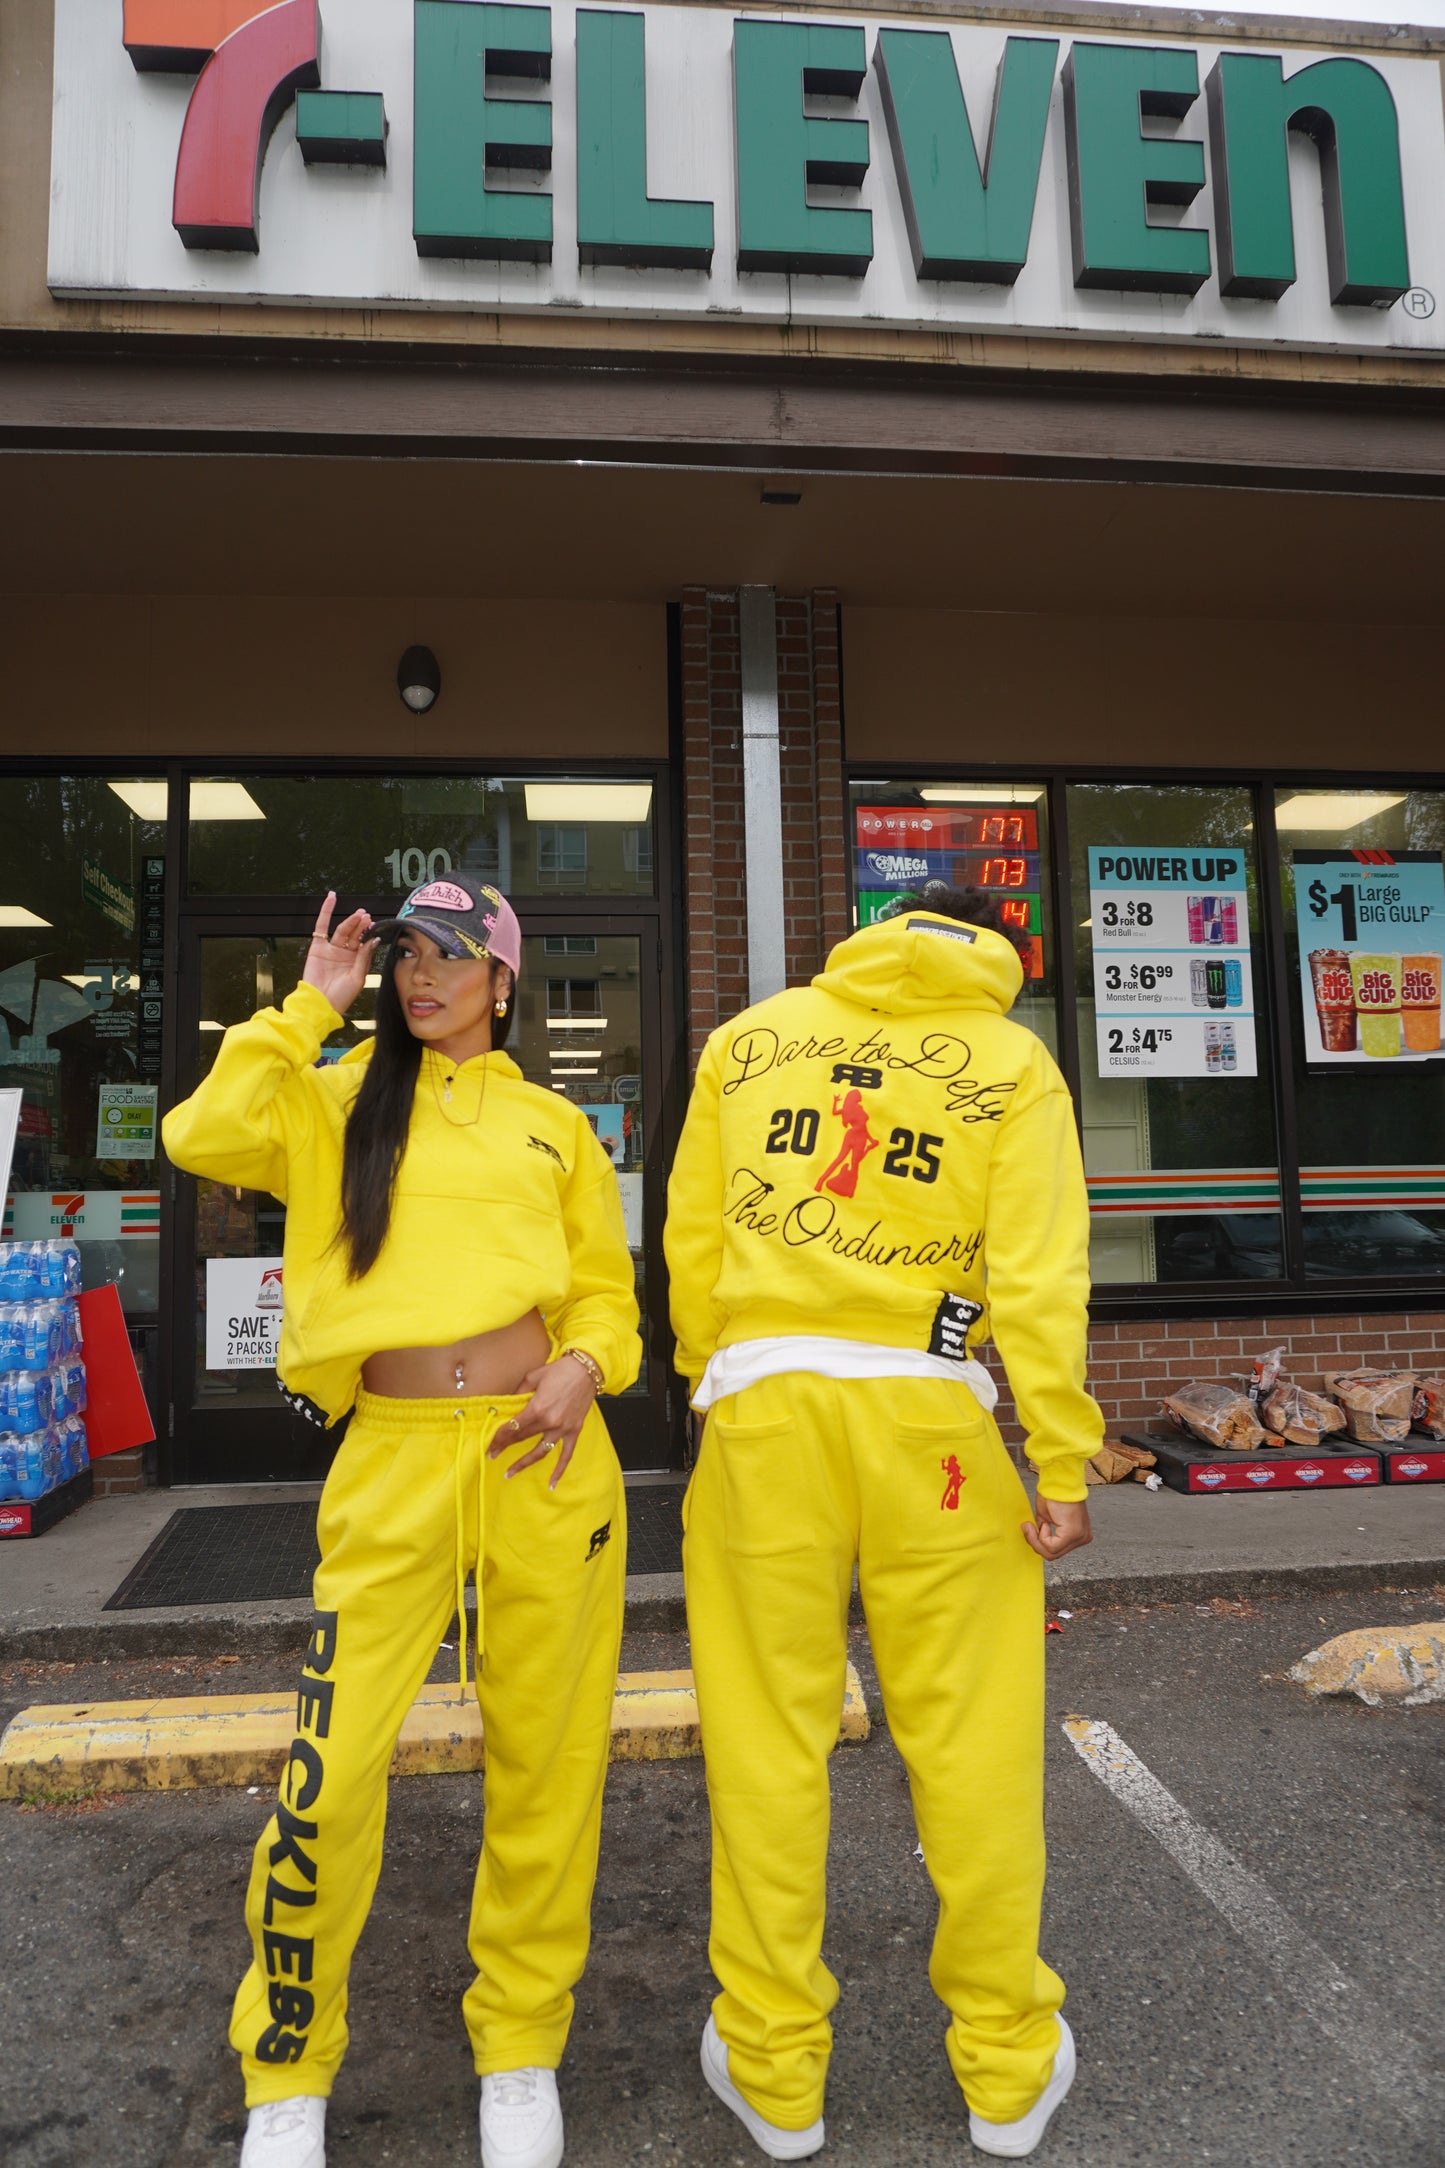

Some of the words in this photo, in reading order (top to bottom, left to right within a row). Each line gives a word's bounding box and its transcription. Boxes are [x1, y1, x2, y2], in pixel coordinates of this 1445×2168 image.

[982, 817, 1022, 841] 177
[384, 848, 451, 888] 100
[886, 856, 928, 871] MEGA
[984, 859, 1024, 885] 173
[1098, 857, 1188, 881] POWER
[1192, 858, 1238, 881] UP
[885, 871, 928, 880] MILLIONS
[84, 860, 100, 887] Self
[101, 874, 134, 913] Checkout
[430, 886, 463, 903] Dutch
[1358, 884, 1400, 905] Large
[1102, 902, 1119, 926] 3
[1120, 918, 1135, 926] FOR
[1308, 880, 1358, 941] $1
[1360, 906, 1386, 922] BIG
[1389, 905, 1430, 922] GULP
[1103, 929, 1117, 937] Red
[1118, 929, 1132, 937] Bull
[1105, 965, 1122, 990] 3
[1106, 993, 1137, 1001] Monster
[1138, 993, 1162, 1003] Energy
[1317, 986, 1354, 1001] GULP
[1359, 988, 1396, 1004] GULP
[1401, 986, 1436, 1001] GULP
[1108, 1029, 1123, 1053] 2
[723, 1028, 848, 1096] Dare
[851, 1028, 893, 1065] to
[1109, 1057, 1140, 1065] CELSIUS
[102, 1095, 133, 1104] FOOD
[127, 1112, 142, 1120] OKAY
[765, 1108, 820, 1156] 20
[882, 1127, 944, 1184] 25
[724, 1168, 779, 1236] The
[11, 1269, 33, 1277] WATER
[228, 1317, 269, 1338] SAVE
[227, 1342, 233, 1355] 2
[236, 1341, 272, 1355] PACKS
[257, 1356, 277, 1364] 7-ELE
